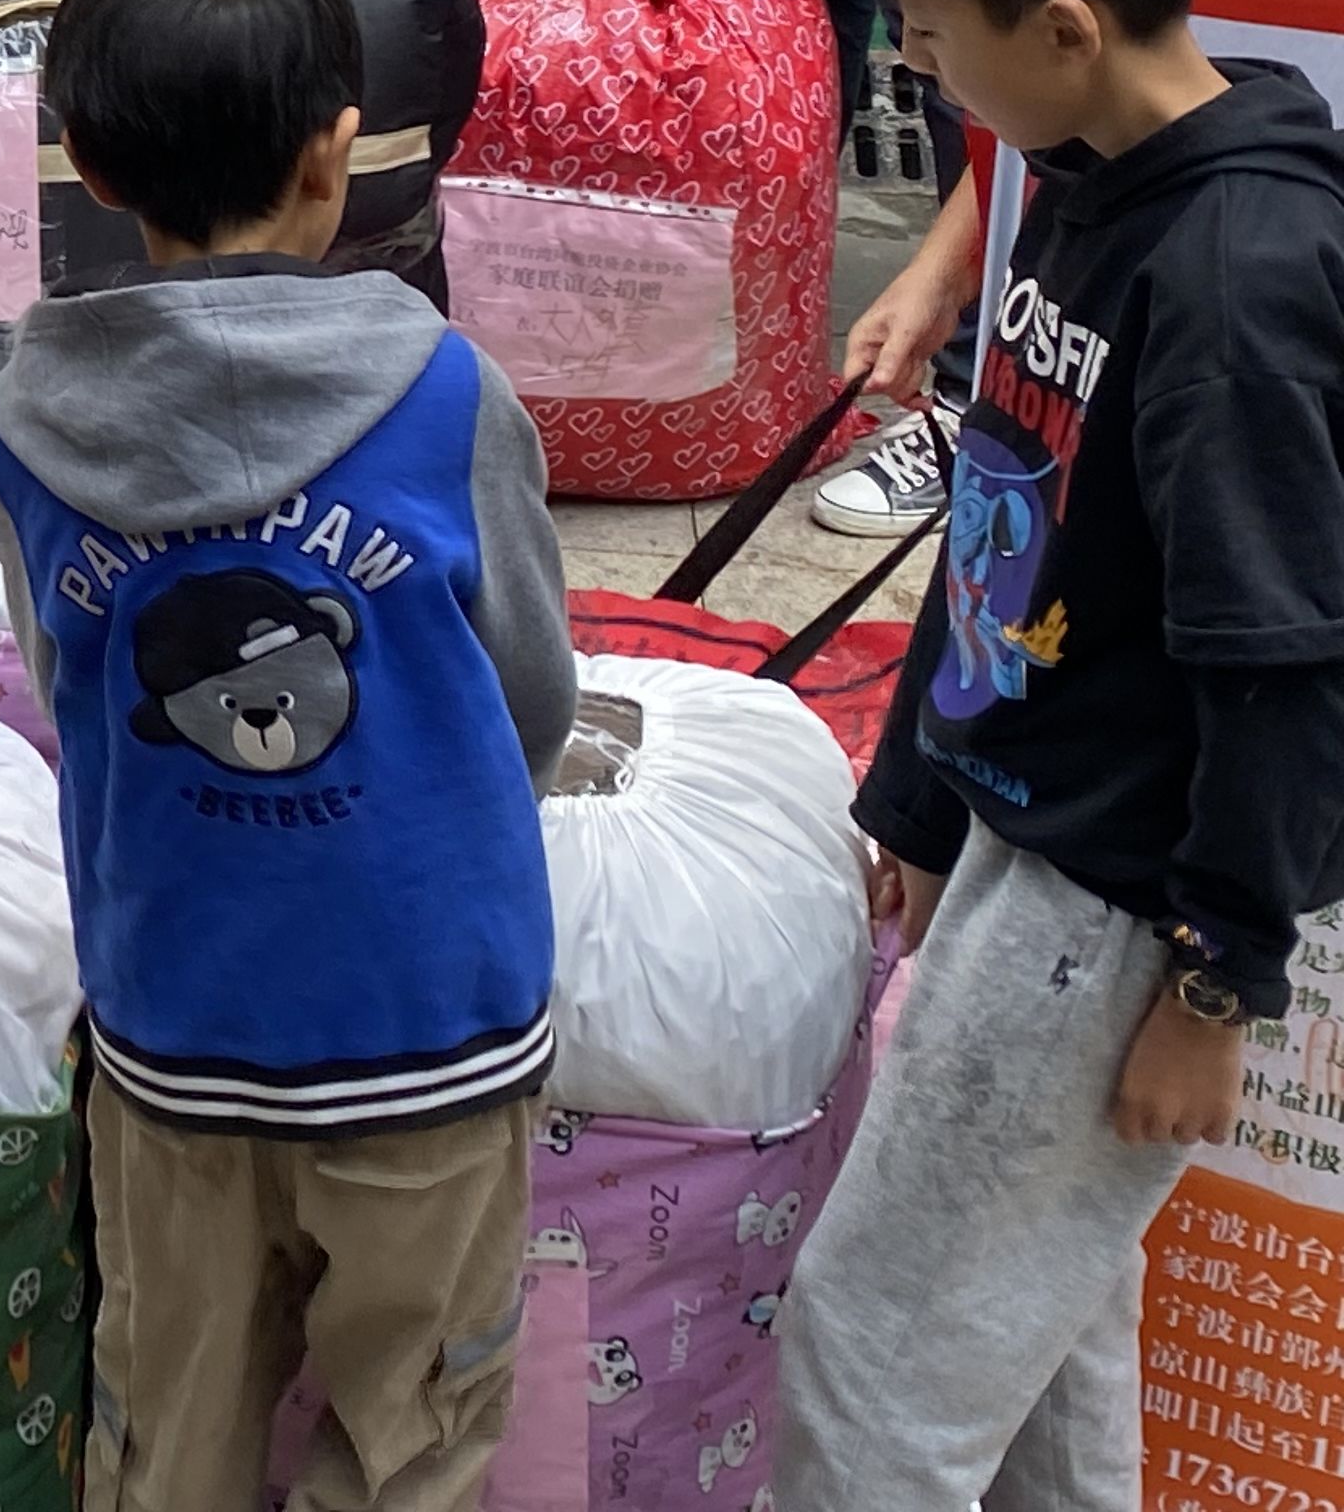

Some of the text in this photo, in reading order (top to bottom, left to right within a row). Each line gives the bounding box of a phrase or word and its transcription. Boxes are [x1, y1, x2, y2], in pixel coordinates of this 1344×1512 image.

[648, 1184, 678, 1262] Zoom
[1169, 1198, 1344, 1282] 宁波市台
[1161, 1244, 1344, 1331] 家联会会
